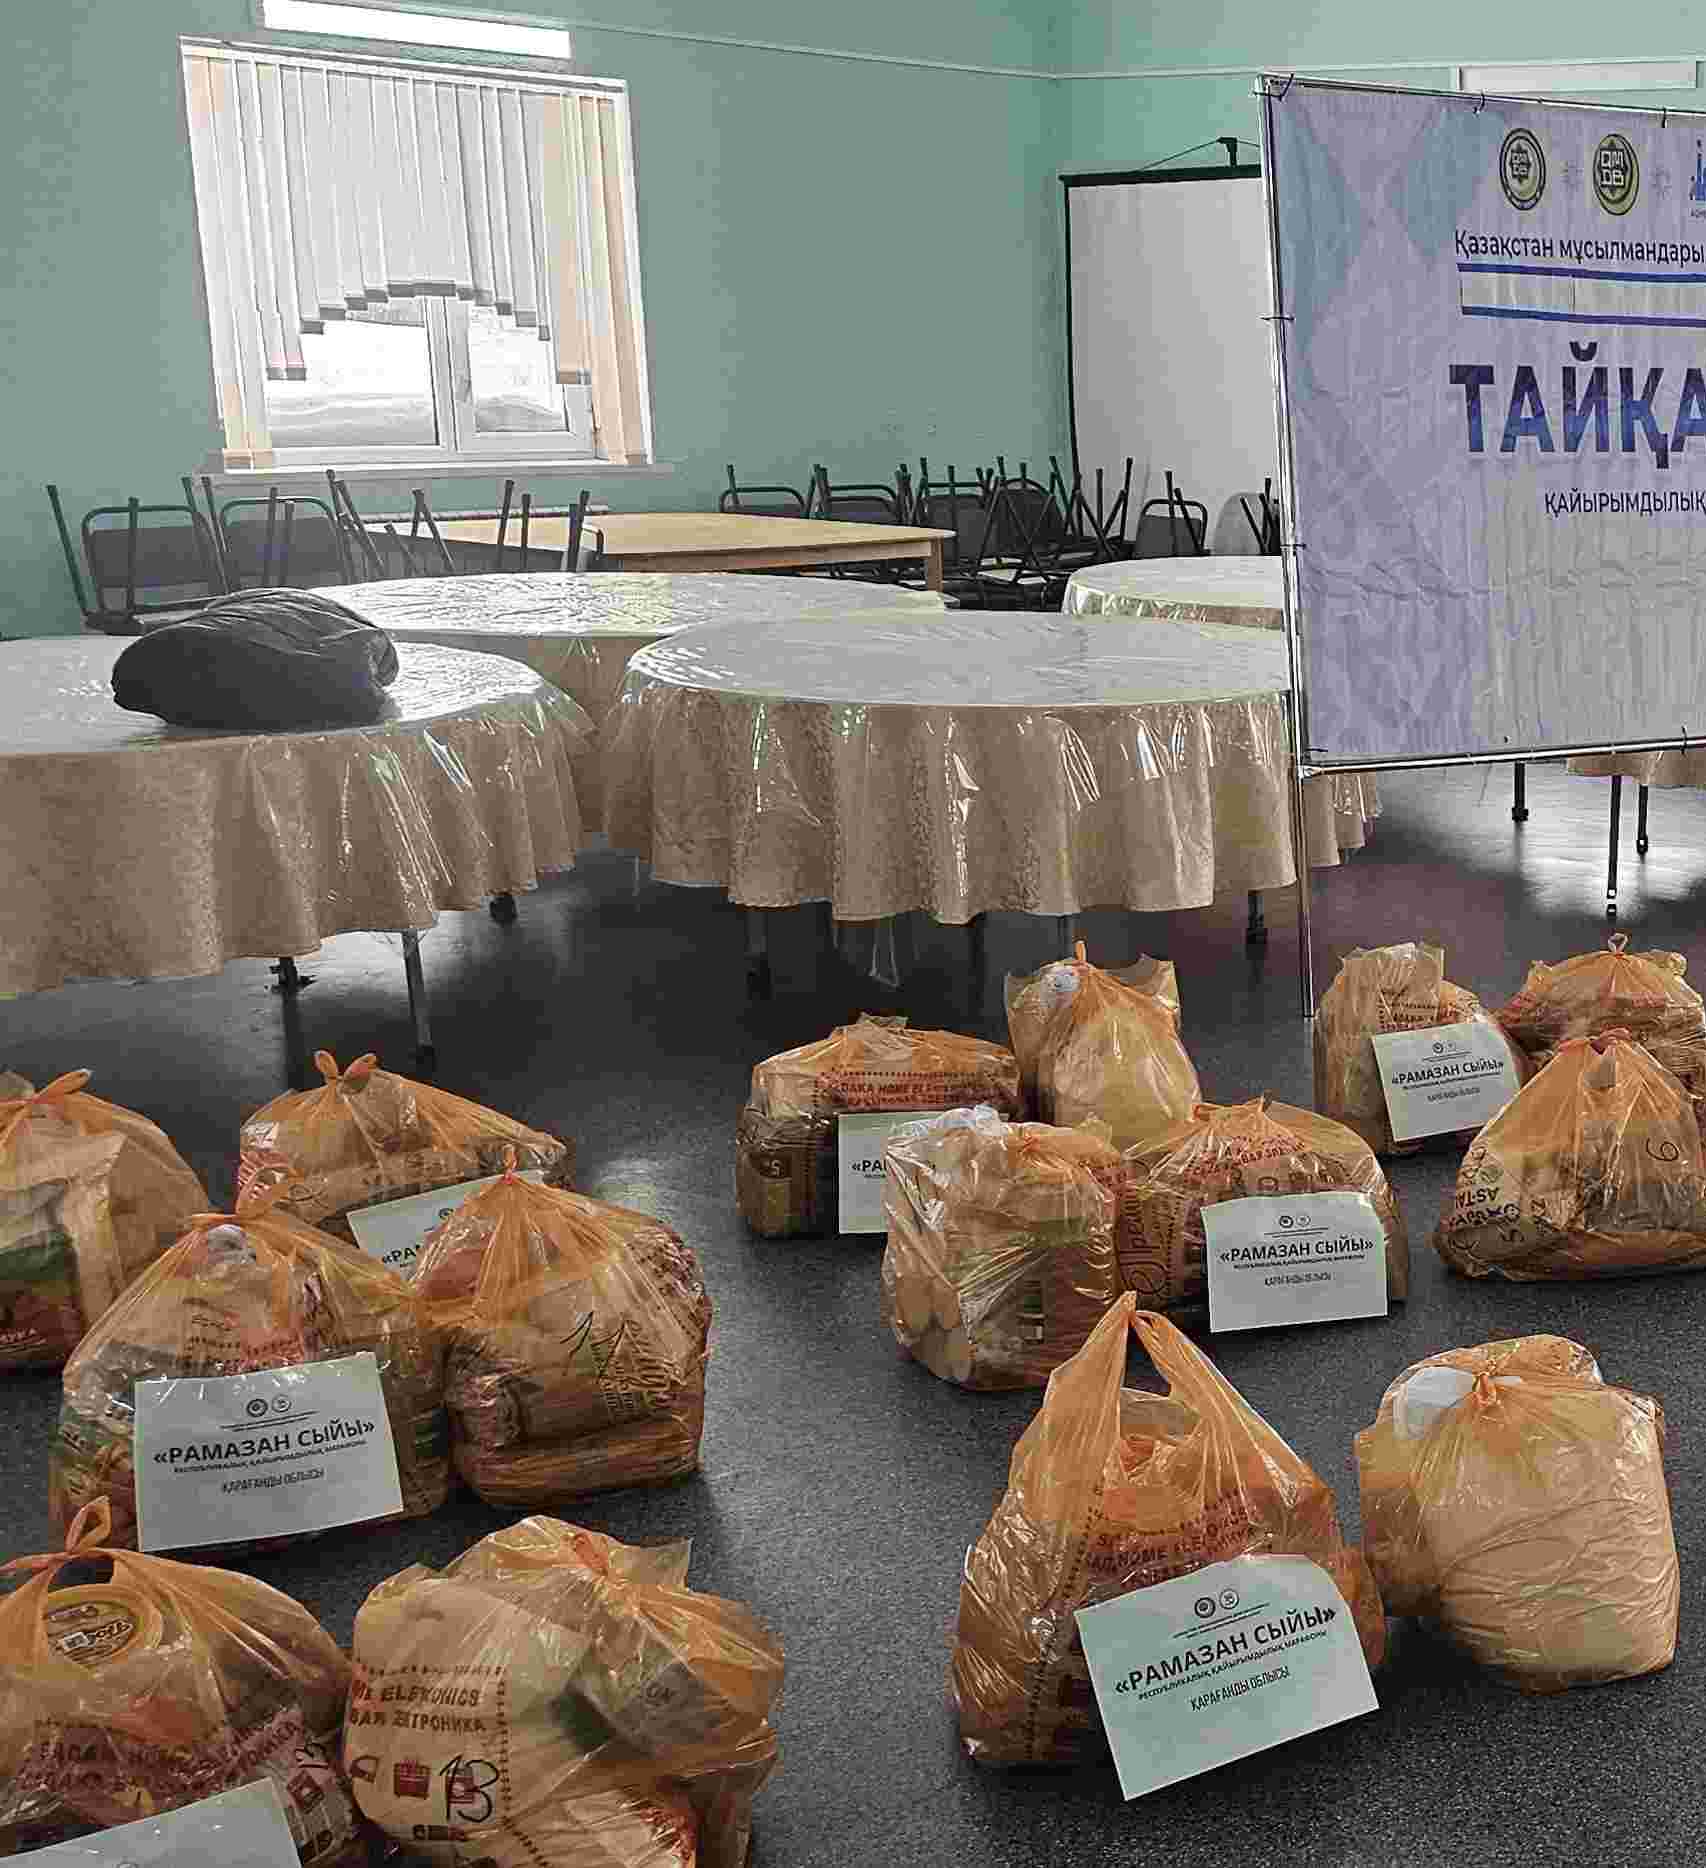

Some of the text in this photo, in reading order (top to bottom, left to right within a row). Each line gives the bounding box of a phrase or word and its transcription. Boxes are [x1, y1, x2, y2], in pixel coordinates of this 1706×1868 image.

[1454, 230, 1553, 260] Қазақстан
[1559, 238, 1705, 268] мұсылмандары
[1544, 488, 1706, 518] ҚАЙЫРЫМДЫЛЫҚ
[1219, 1239, 1310, 1264] «РАМАЗАН
[1315, 1235, 1374, 1255] СЫЙЫ»
[153, 1418, 375, 1464] «РАМАЗАН СЫЙЫ»
[1115, 1606, 1337, 1694] «РАМАЗАН СЫЙЫ»
